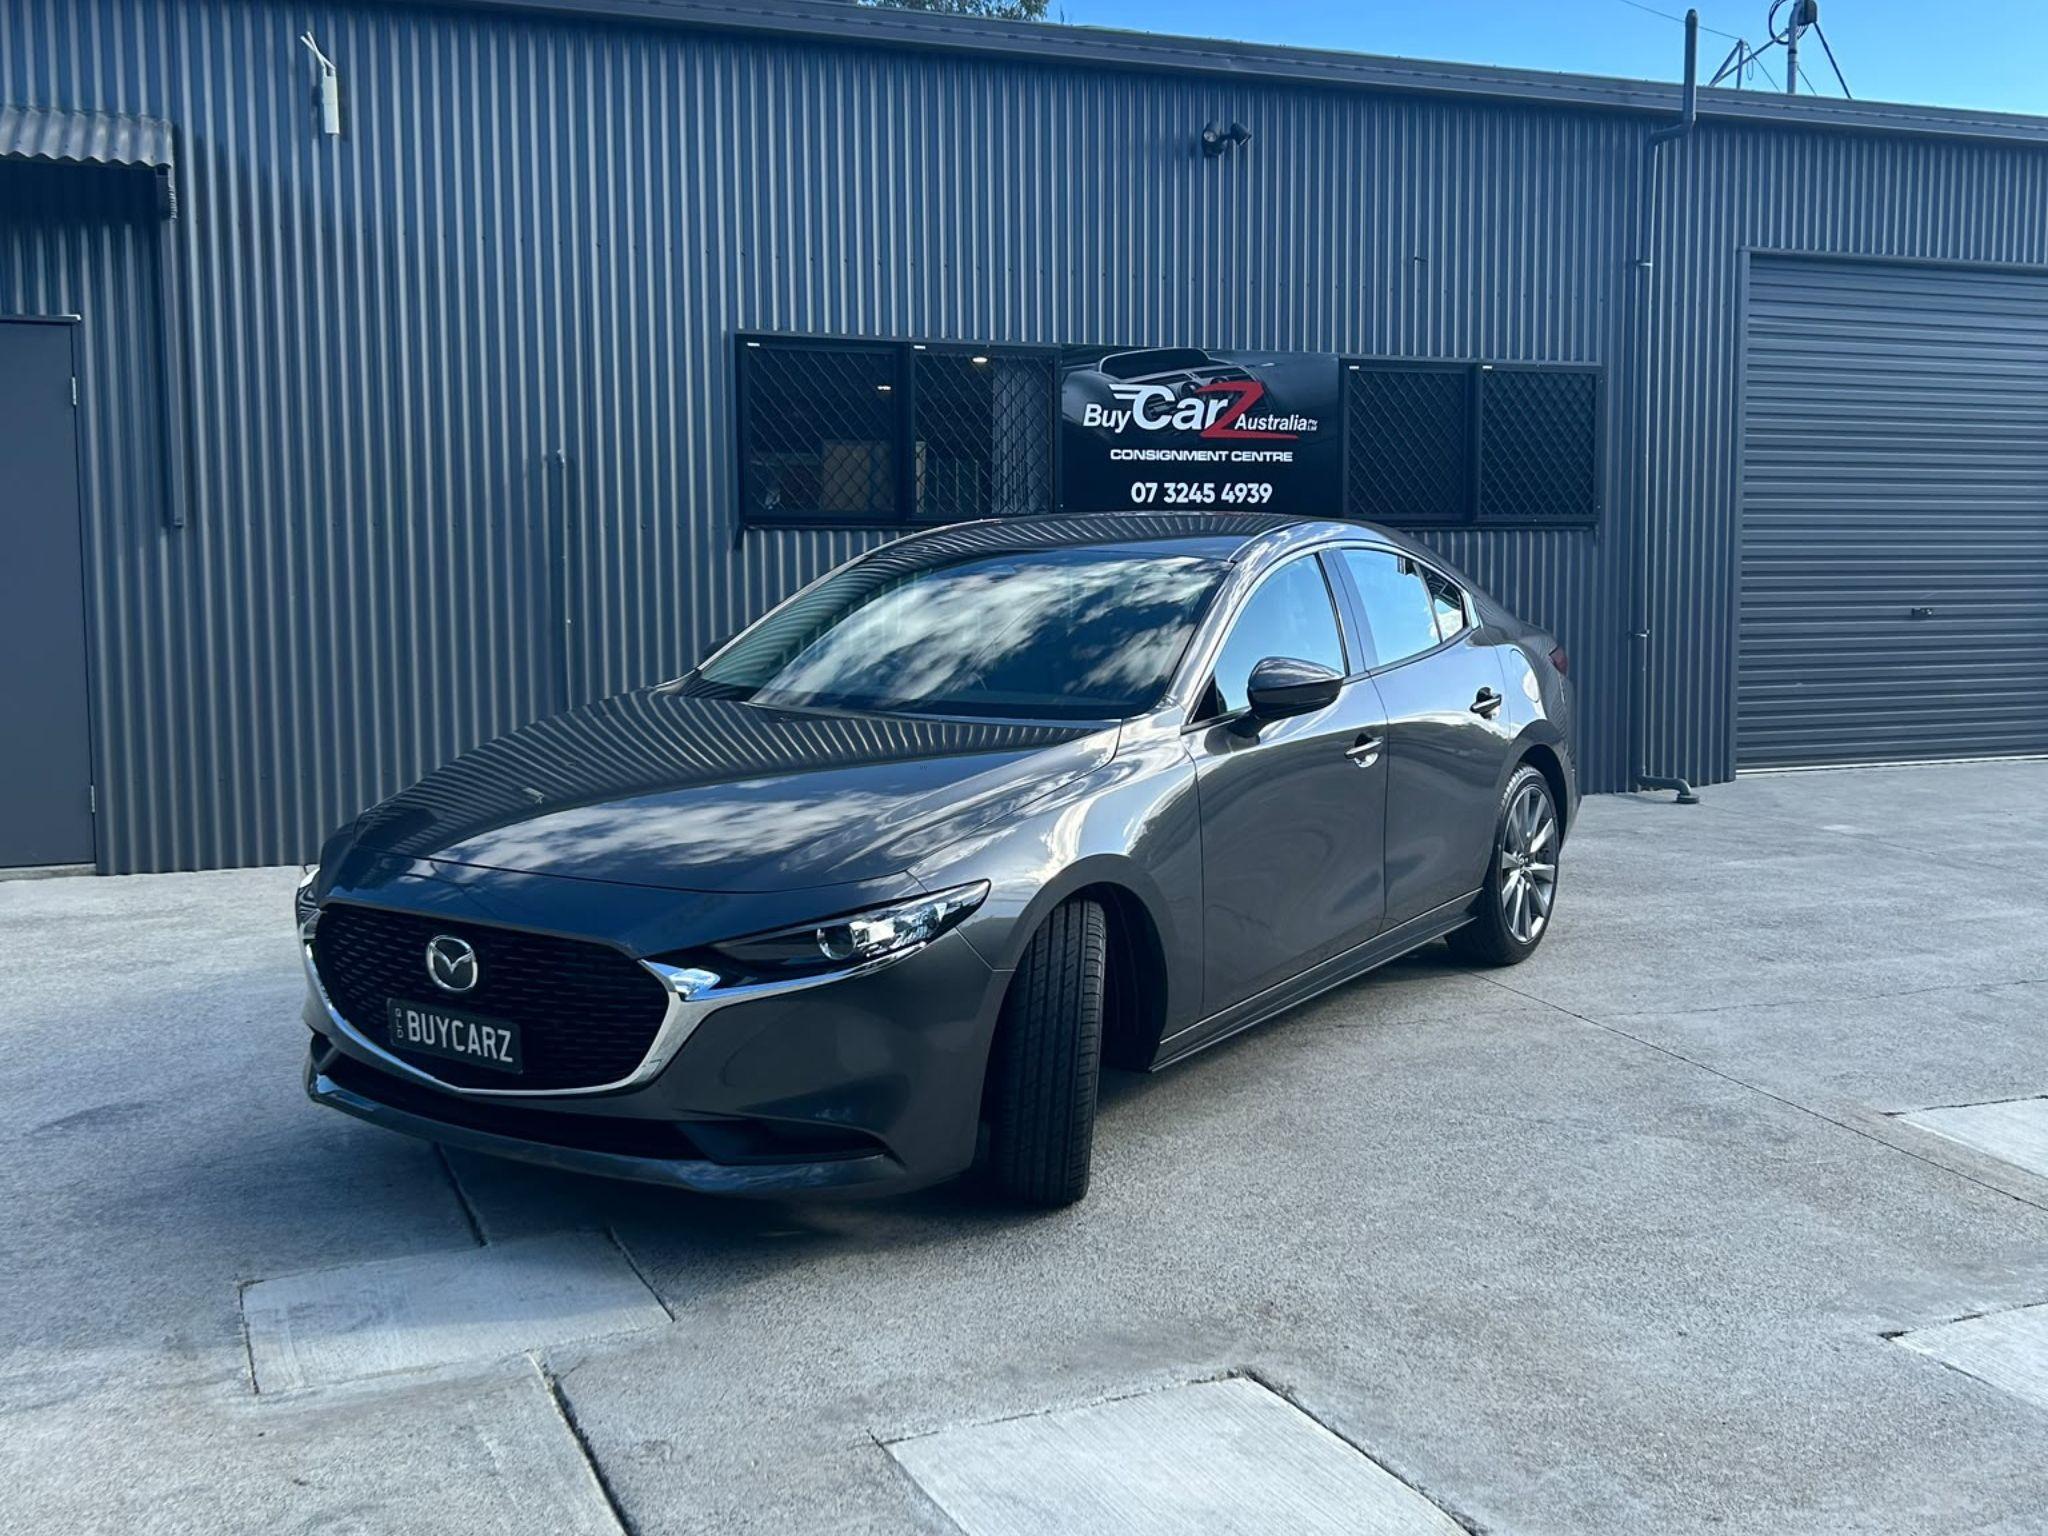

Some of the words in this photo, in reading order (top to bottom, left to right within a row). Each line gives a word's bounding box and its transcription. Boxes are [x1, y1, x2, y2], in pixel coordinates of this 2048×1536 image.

[1083, 404, 1133, 433] Buy
[1234, 413, 1307, 431] Australia
[1110, 449, 1229, 462] CONSIGNMENT
[1231, 450, 1293, 462] CENTRE
[1131, 481, 1158, 504] 07
[1163, 481, 1215, 504] 3245
[1220, 482, 1273, 504] 4939
[406, 1010, 513, 1063] BUYCARZ
